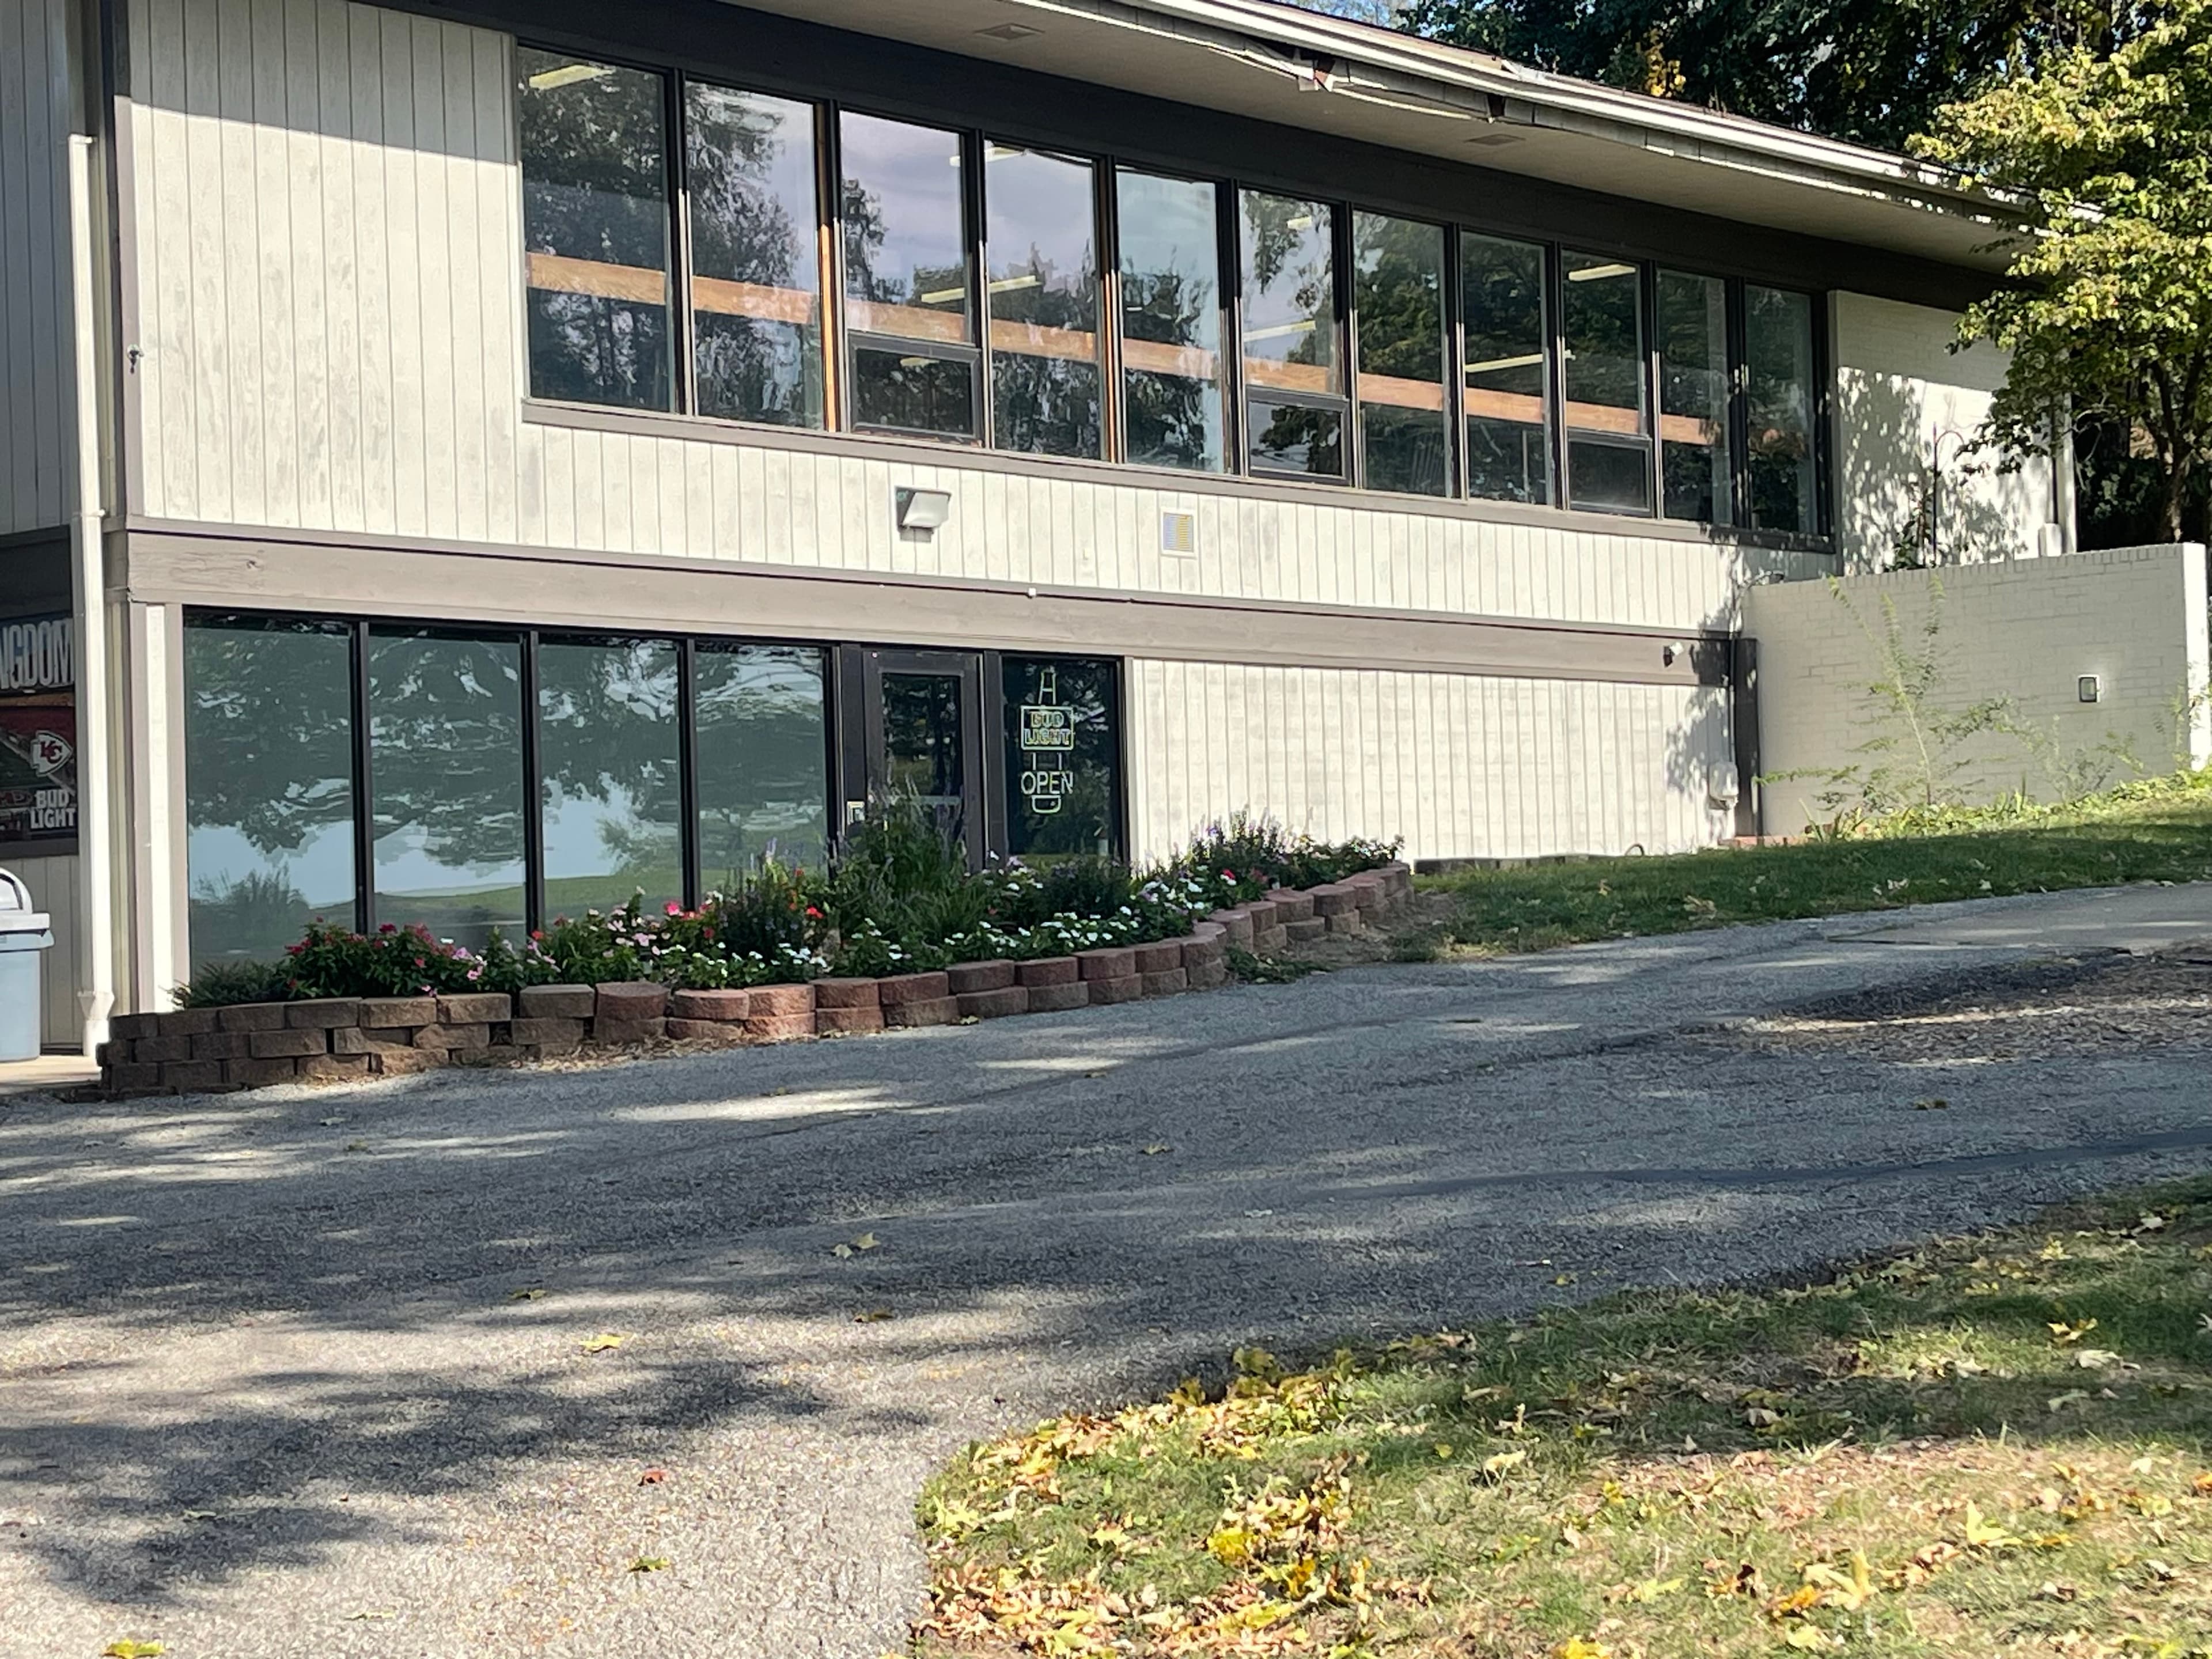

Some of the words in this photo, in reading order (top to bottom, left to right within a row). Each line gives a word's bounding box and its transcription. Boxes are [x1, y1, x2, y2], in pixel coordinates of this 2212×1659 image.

[1030, 711, 1065, 728] BUD
[1025, 728, 1071, 745] LIGHT
[41, 741, 62, 764] KC
[1021, 771, 1073, 794] OPEN
[36, 790, 69, 809] BUD
[30, 808, 75, 828] LIGHT
